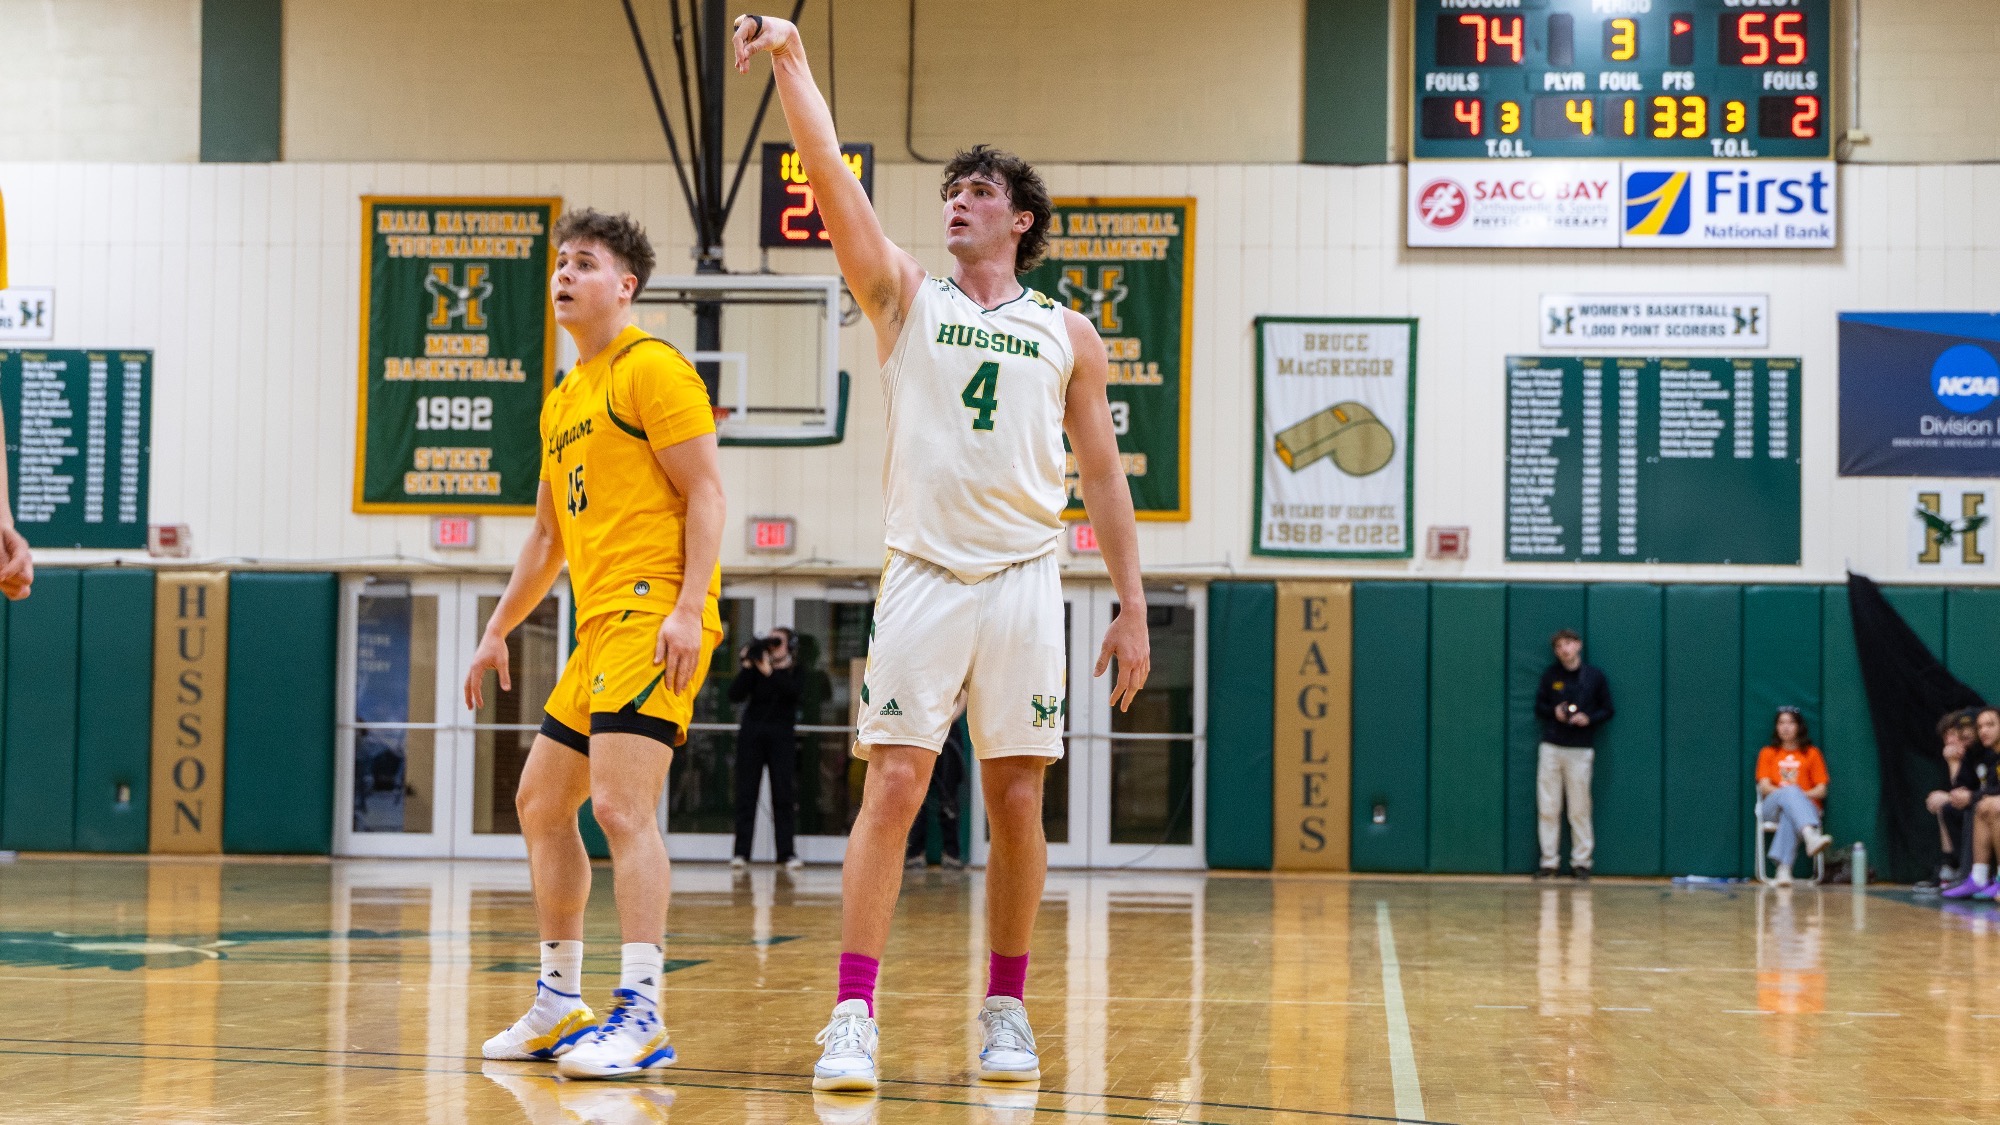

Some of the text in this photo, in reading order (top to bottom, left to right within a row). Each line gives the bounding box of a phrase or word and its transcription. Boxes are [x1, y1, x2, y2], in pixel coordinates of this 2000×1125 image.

[1459, 14, 1522, 63] 74
[1611, 18, 1635, 61] 3
[1738, 12, 1807, 65] 55
[1425, 72, 1480, 91] FOULS
[1543, 72, 1586, 91] PLYR
[1599, 72, 1643, 91] FOUL
[1662, 71, 1695, 90] PTS
[1763, 71, 1818, 90] FOULS
[1454, 99, 1481, 136] 4
[1501, 101, 1520, 134] 3
[1565, 99, 1593, 136] 4
[1623, 99, 1635, 136] 1
[1653, 96, 1706, 138] 33
[1726, 101, 1746, 133] 3
[1791, 96, 1819, 137] 2
[1485, 138, 1532, 158] T.O.L.
[1710, 138, 1758, 158] T.O.L.
[1474, 181, 1608, 200] SACO BAY
[1707, 171, 1829, 214] First
[434, 211, 544, 236] NATIONAL
[1067, 212, 1180, 237] NATIONAL
[1704, 224, 1830, 239] National Bank
[386, 235, 534, 259] TOURNAMENT
[1041, 236, 1170, 260] URNAMENT
[1579, 304, 1728, 317] WOMEN'S BASKETBALL
[936, 322, 1040, 358] HUSSON
[1304, 333, 1369, 352] BRUCE
[1582, 324, 1726, 337] 1,000 POINT SCORERS
[424, 333, 490, 357] MENS
[384, 357, 527, 382] BASKETBALL
[961, 361, 1000, 431] 4
[1937, 376, 2000, 397] NCAA
[415, 396, 493, 430] 1992
[1920, 415, 1994, 436] Division
[413, 447, 492, 471] SWEET
[404, 471, 501, 495] SIXTEEN
[567, 464, 588, 518] 45
[1267, 522, 1400, 545] 1968-2022
[171, 584, 207, 836] HUSSON
[880, 708, 903, 716] adidas
[1297, 596, 1329, 854] EAGLES
